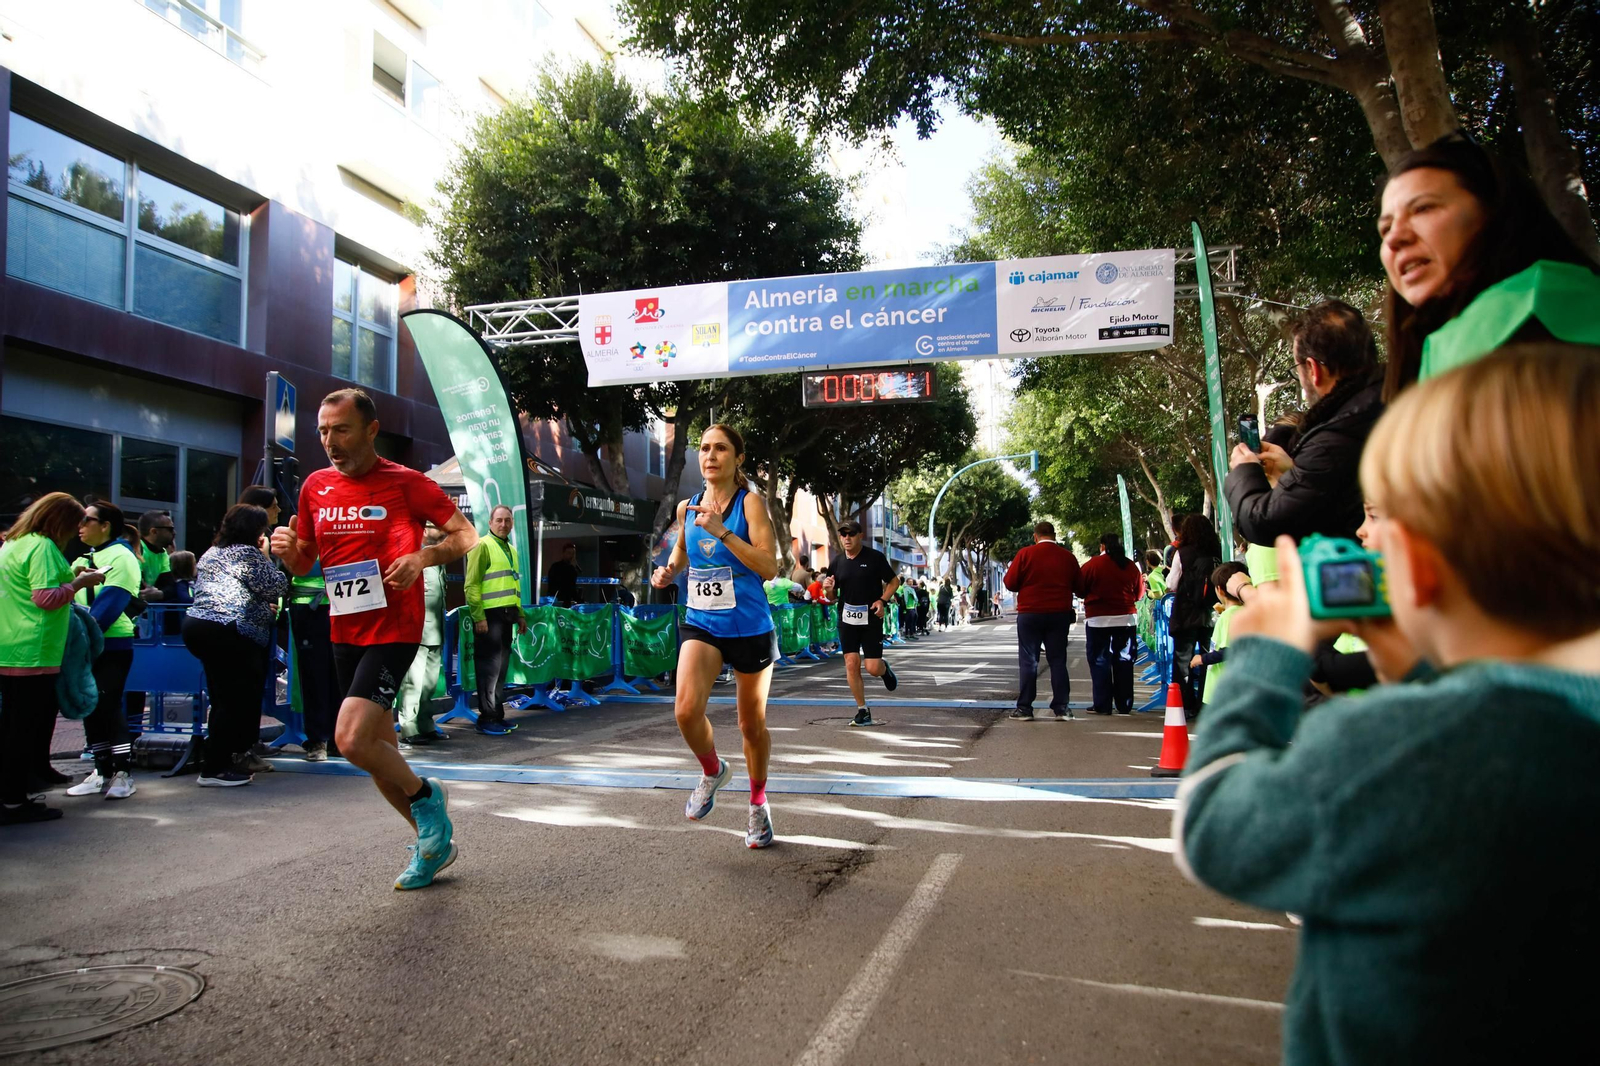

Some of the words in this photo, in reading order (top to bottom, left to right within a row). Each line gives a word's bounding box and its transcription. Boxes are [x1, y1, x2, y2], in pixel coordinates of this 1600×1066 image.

[1028, 270, 1080, 284] cajamar
[744, 284, 838, 310] Almería
[845, 284, 875, 300] en
[884, 274, 980, 299] marcha
[1079, 296, 1138, 310] Fundación
[744, 313, 823, 336] contra
[829, 309, 852, 330] el
[860, 306, 948, 329] cáncer
[1109, 315, 1130, 324] Ejido
[1132, 313, 1159, 322] Motor
[966, 332, 991, 340] española
[1034, 326, 1060, 334] Toyota
[1034, 334, 1064, 342] Alborán
[586, 348, 619, 358] ALMERÍA
[738, 351, 818, 364] #TodosContraElCáncer
[334, 578, 370, 598] 472
[695, 582, 723, 596] 183
[846, 610, 863, 619] 340
